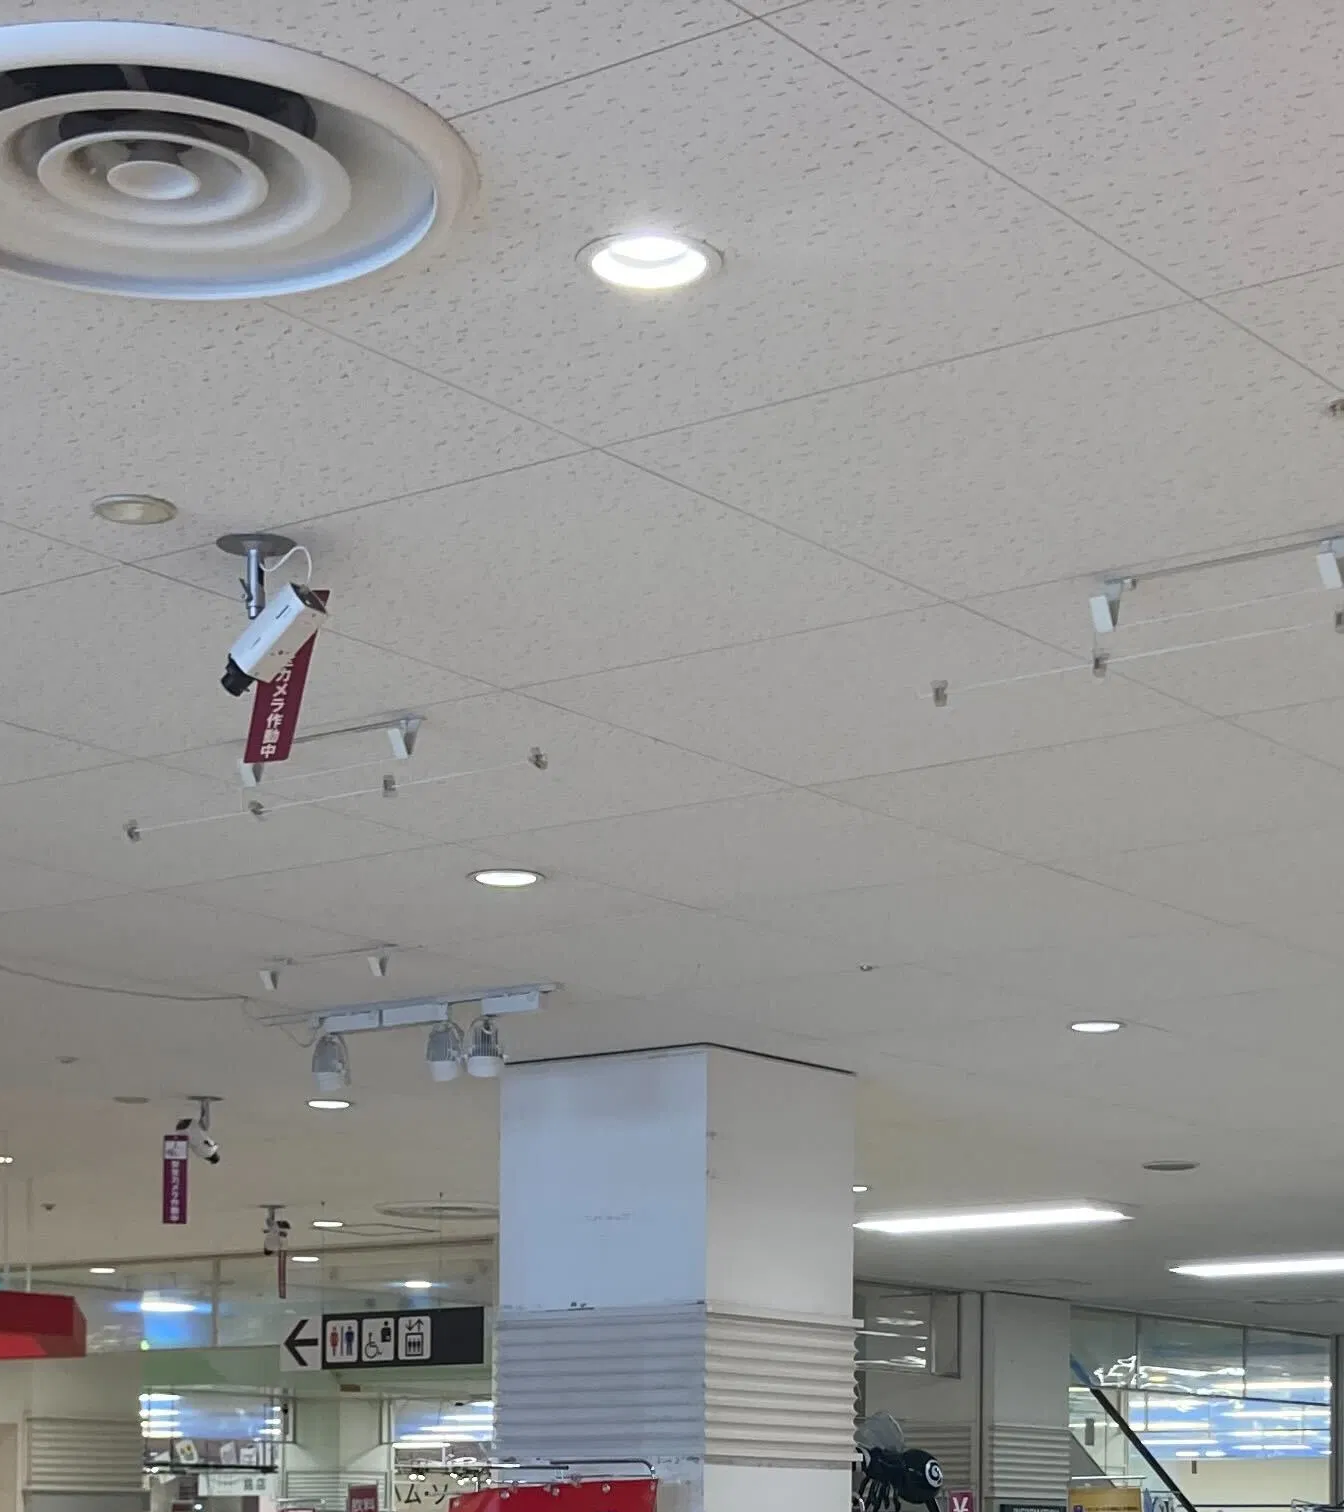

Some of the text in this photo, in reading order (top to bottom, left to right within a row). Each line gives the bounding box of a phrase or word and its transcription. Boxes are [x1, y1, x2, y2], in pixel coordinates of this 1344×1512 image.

[260, 661, 294, 758] カメラ作動中
